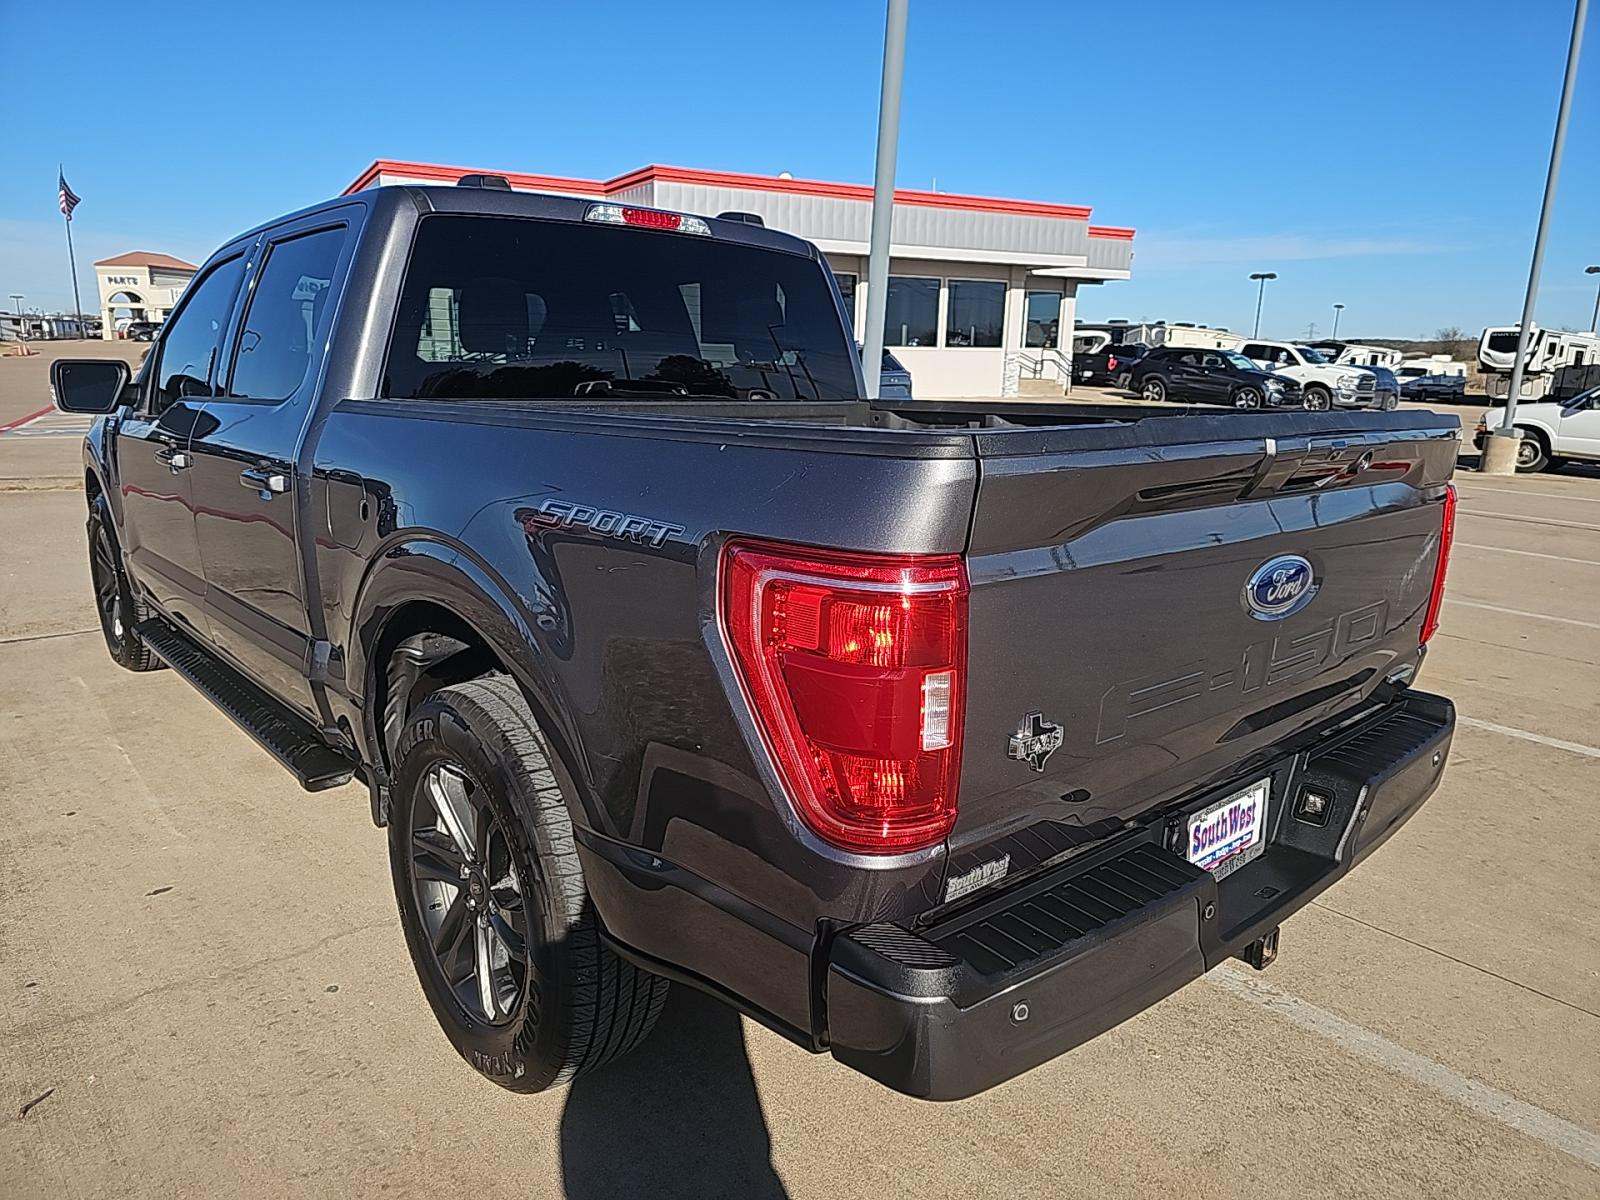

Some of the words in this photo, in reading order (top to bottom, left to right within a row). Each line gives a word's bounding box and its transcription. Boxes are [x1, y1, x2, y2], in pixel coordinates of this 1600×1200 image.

[530, 499, 686, 549] SPORT
[1267, 568, 1304, 602] Ford
[1096, 600, 1392, 744] F-150
[1018, 729, 1061, 759] TEXAS
